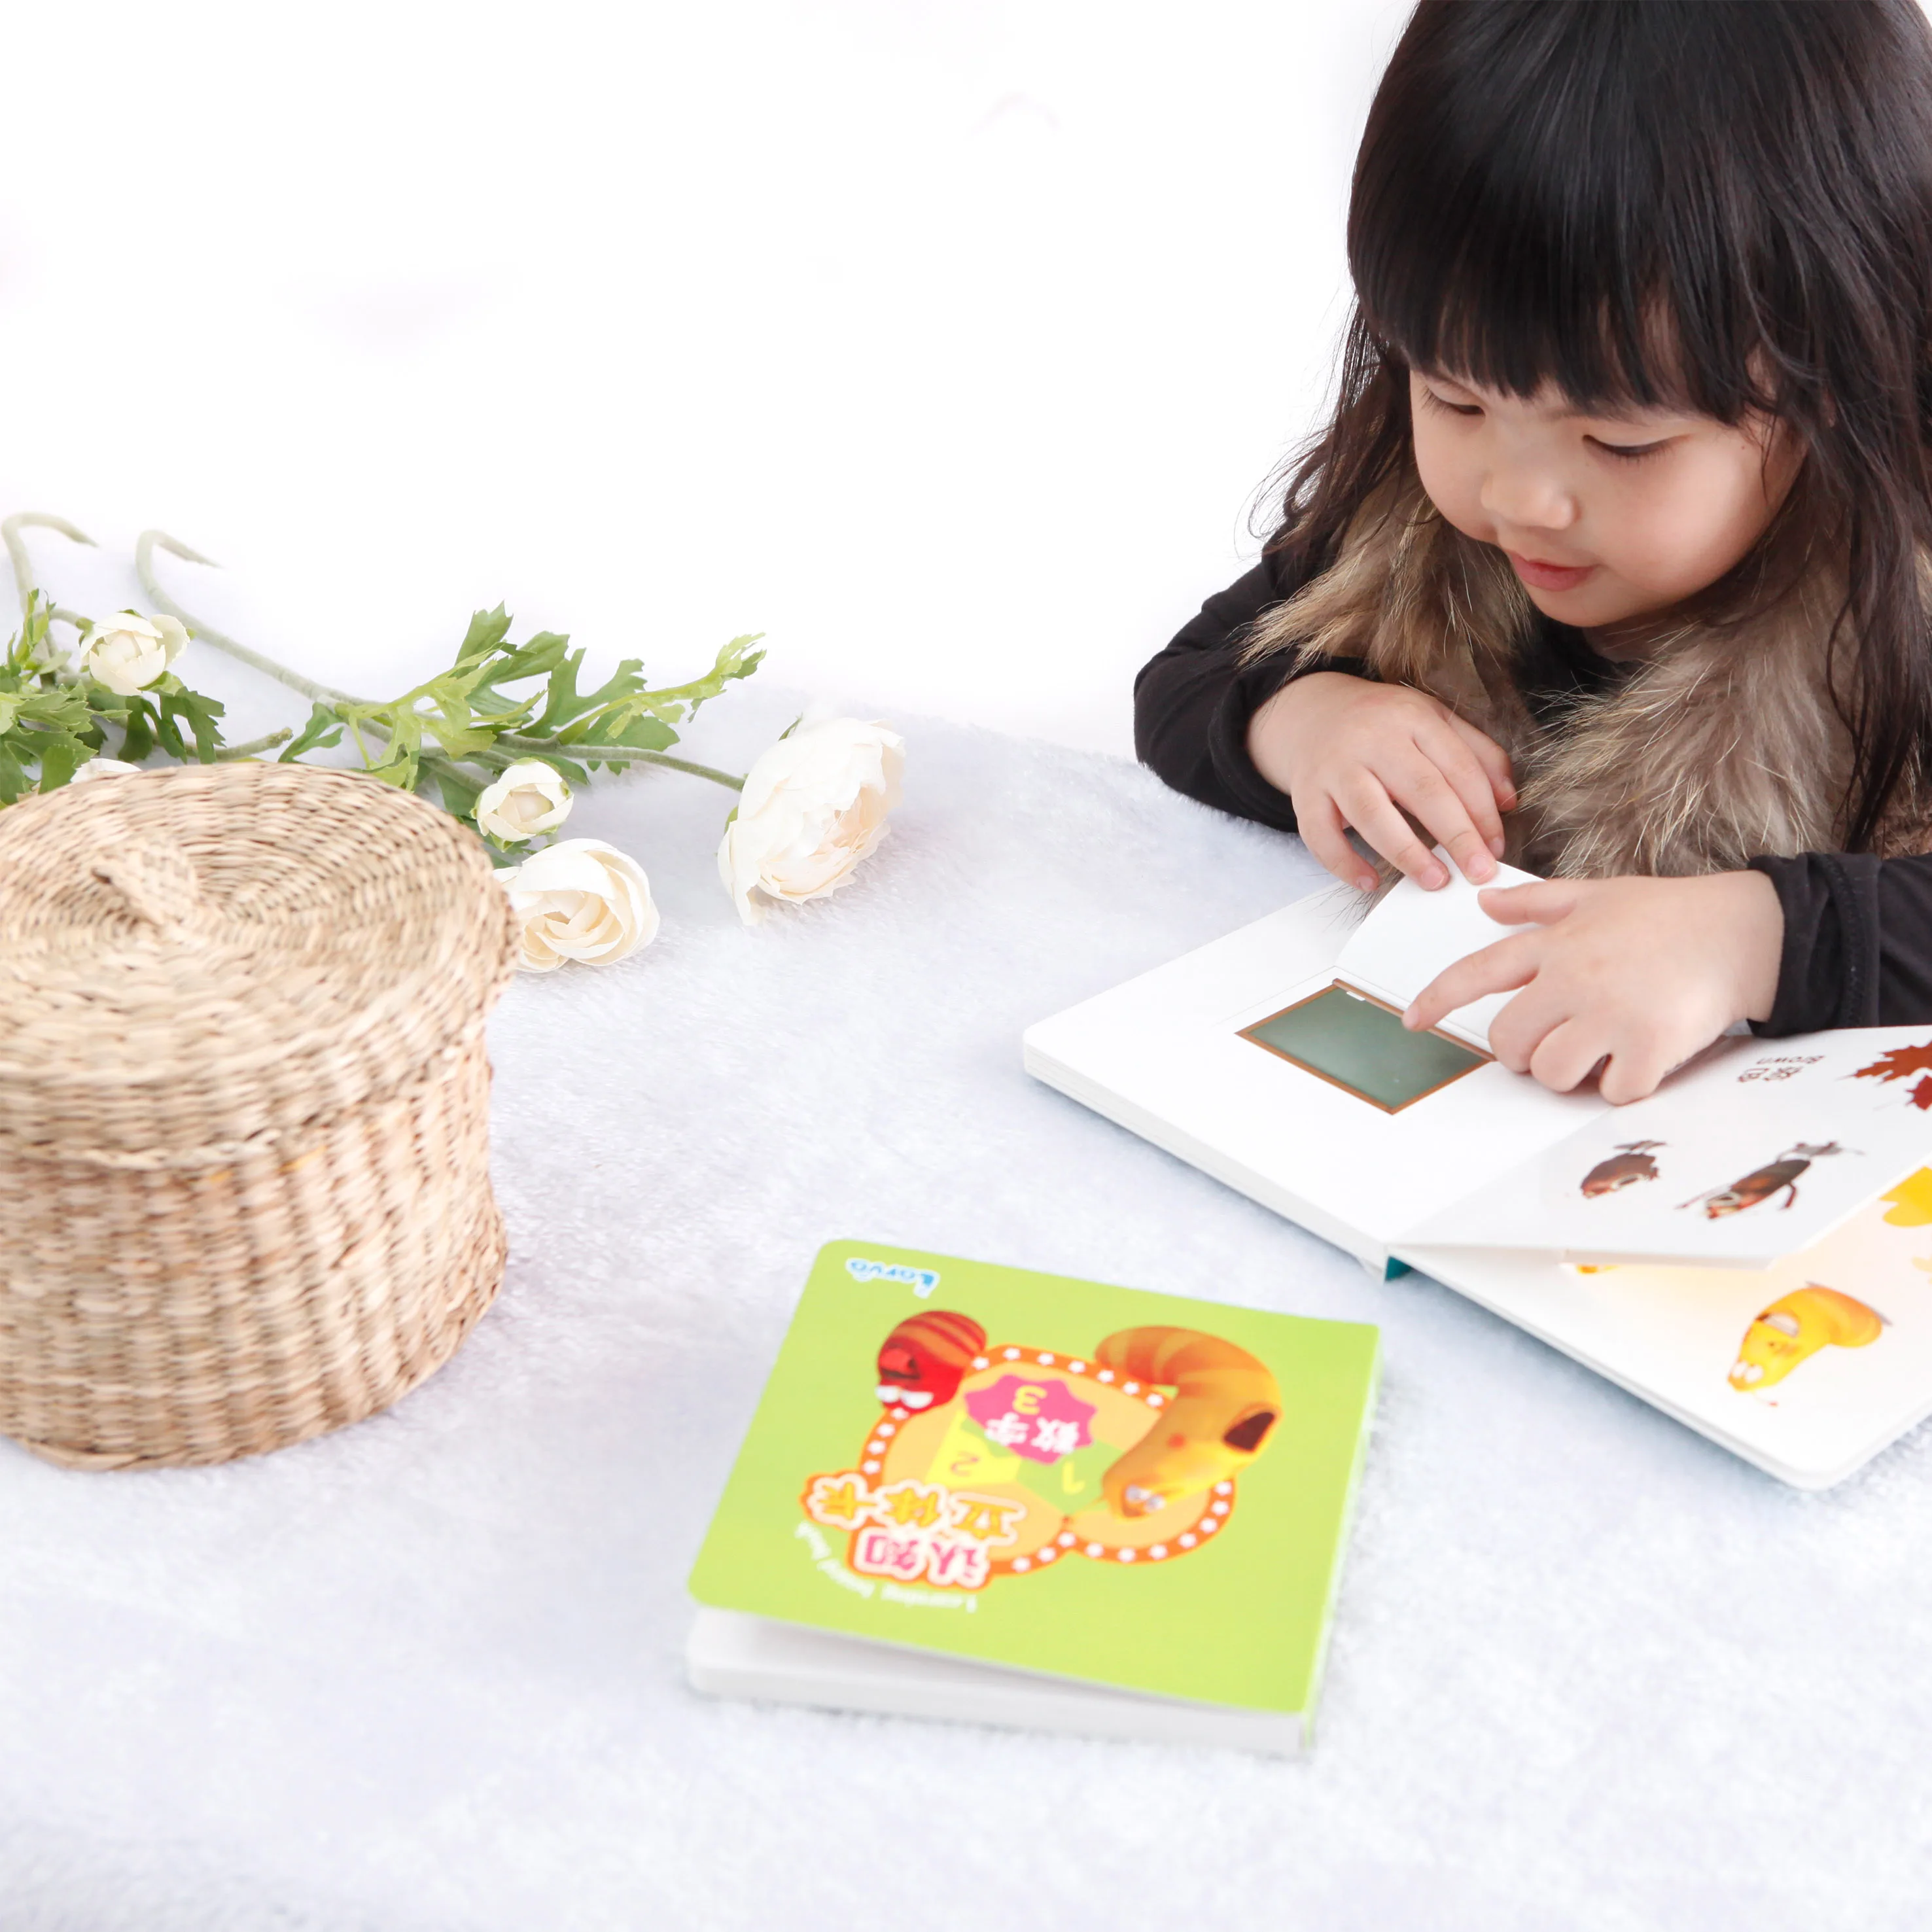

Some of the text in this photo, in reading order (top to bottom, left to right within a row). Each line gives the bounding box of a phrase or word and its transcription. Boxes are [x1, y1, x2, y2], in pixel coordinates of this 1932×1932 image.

[1013, 1385, 1047, 1414] 3
[985, 1413, 1079, 1454] 数字
[951, 1451, 979, 1476] 2
[1063, 1461, 1085, 1495] 1
[814, 1479, 1022, 1541] 立体卡
[861, 1534, 980, 1581] 认知
